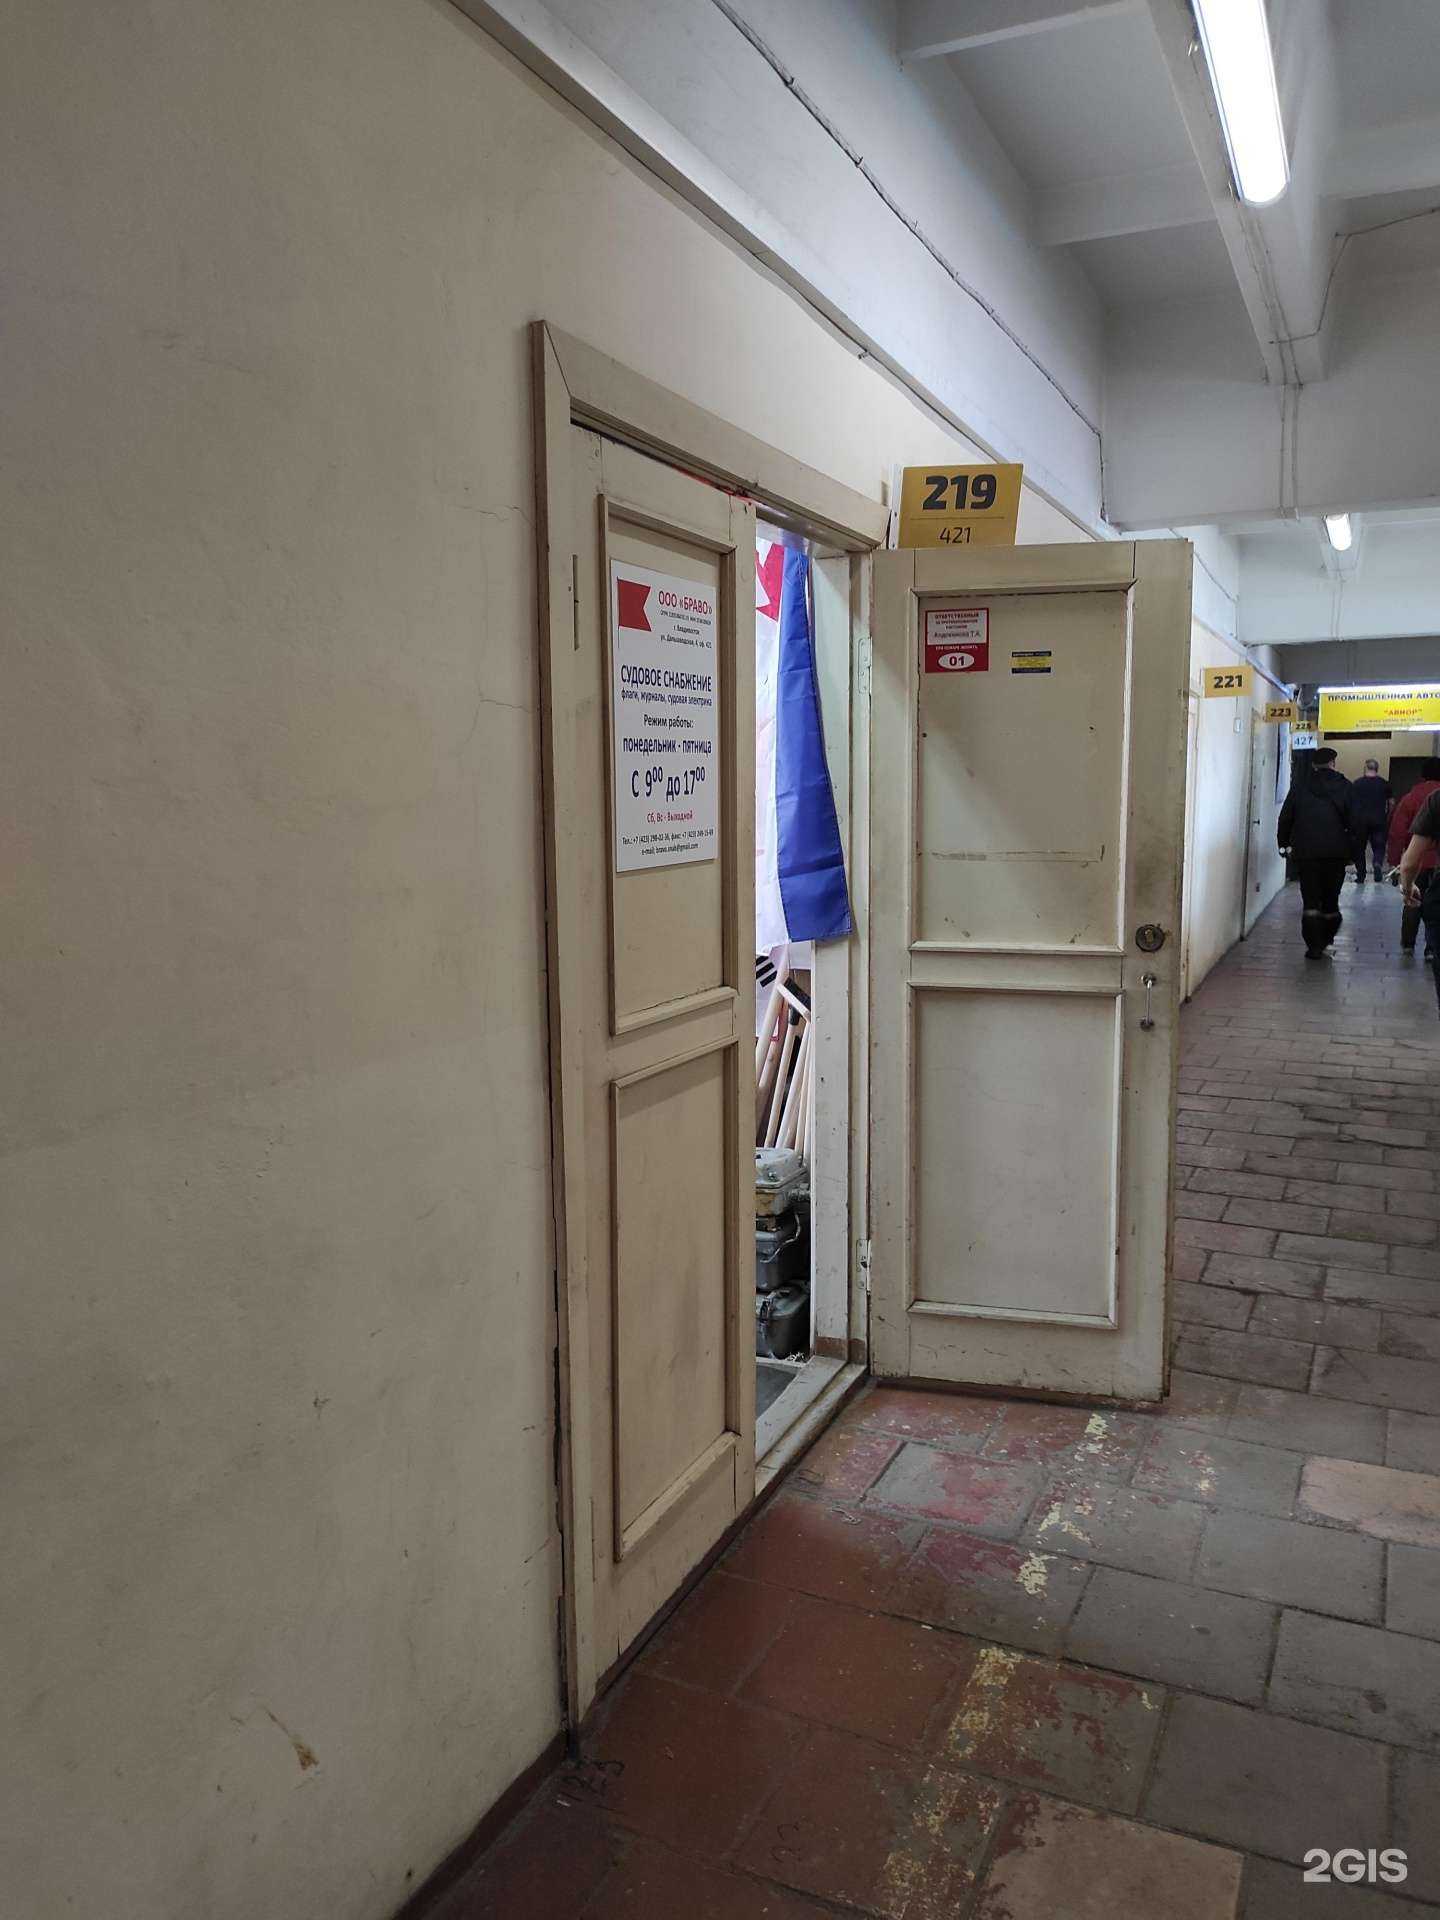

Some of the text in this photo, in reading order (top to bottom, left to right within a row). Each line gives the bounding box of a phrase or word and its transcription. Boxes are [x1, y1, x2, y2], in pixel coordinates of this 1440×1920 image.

[922, 474, 997, 510] 219
[939, 527, 971, 544] 421
[658, 590, 713, 615] ООО «БРАВО»
[949, 656, 965, 667] 01
[620, 664, 712, 692] СУДОВОЕ СНАБЖЕНИЕ
[1213, 675, 1243, 689] 221
[621, 687, 712, 708] флаги, журналы, судовая электрика
[1328, 692, 1413, 702] ПРОМЫШЛЕННАЯ
[1270, 707, 1292, 718] 223
[643, 714, 694, 731] Режим работы:
[622, 737, 677, 757] понедельник
[682, 739, 712, 758] пятница
[666, 775, 681, 803] до
